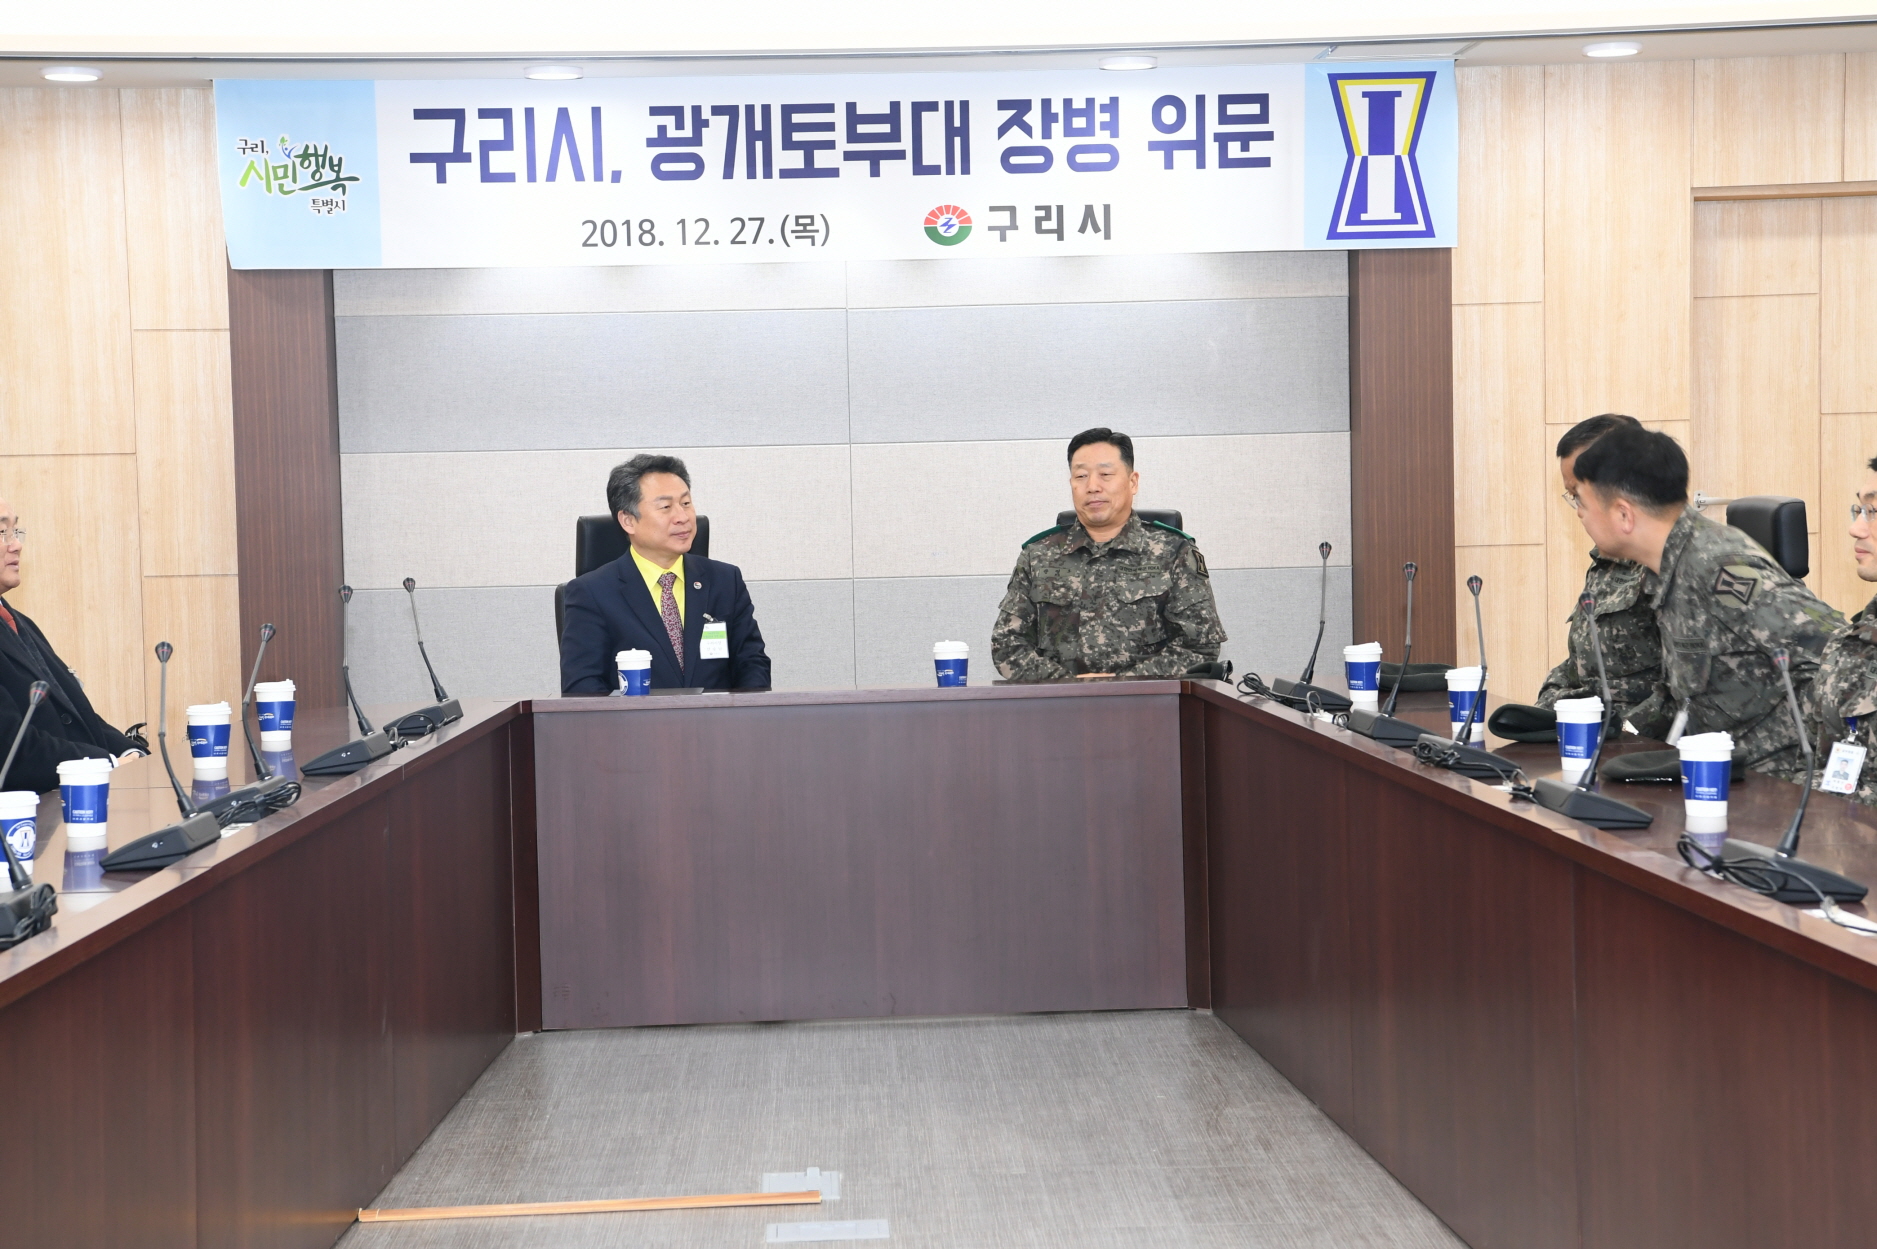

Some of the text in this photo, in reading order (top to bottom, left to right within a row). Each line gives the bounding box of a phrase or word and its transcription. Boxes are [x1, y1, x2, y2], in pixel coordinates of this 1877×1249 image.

[237, 139, 269, 155] 구리,
[409, 92, 1275, 184] 구리시, 광개토부대 장병 위문
[310, 198, 346, 215] 특별시
[582, 218, 665, 248] 2018.
[676, 217, 719, 246] 12.
